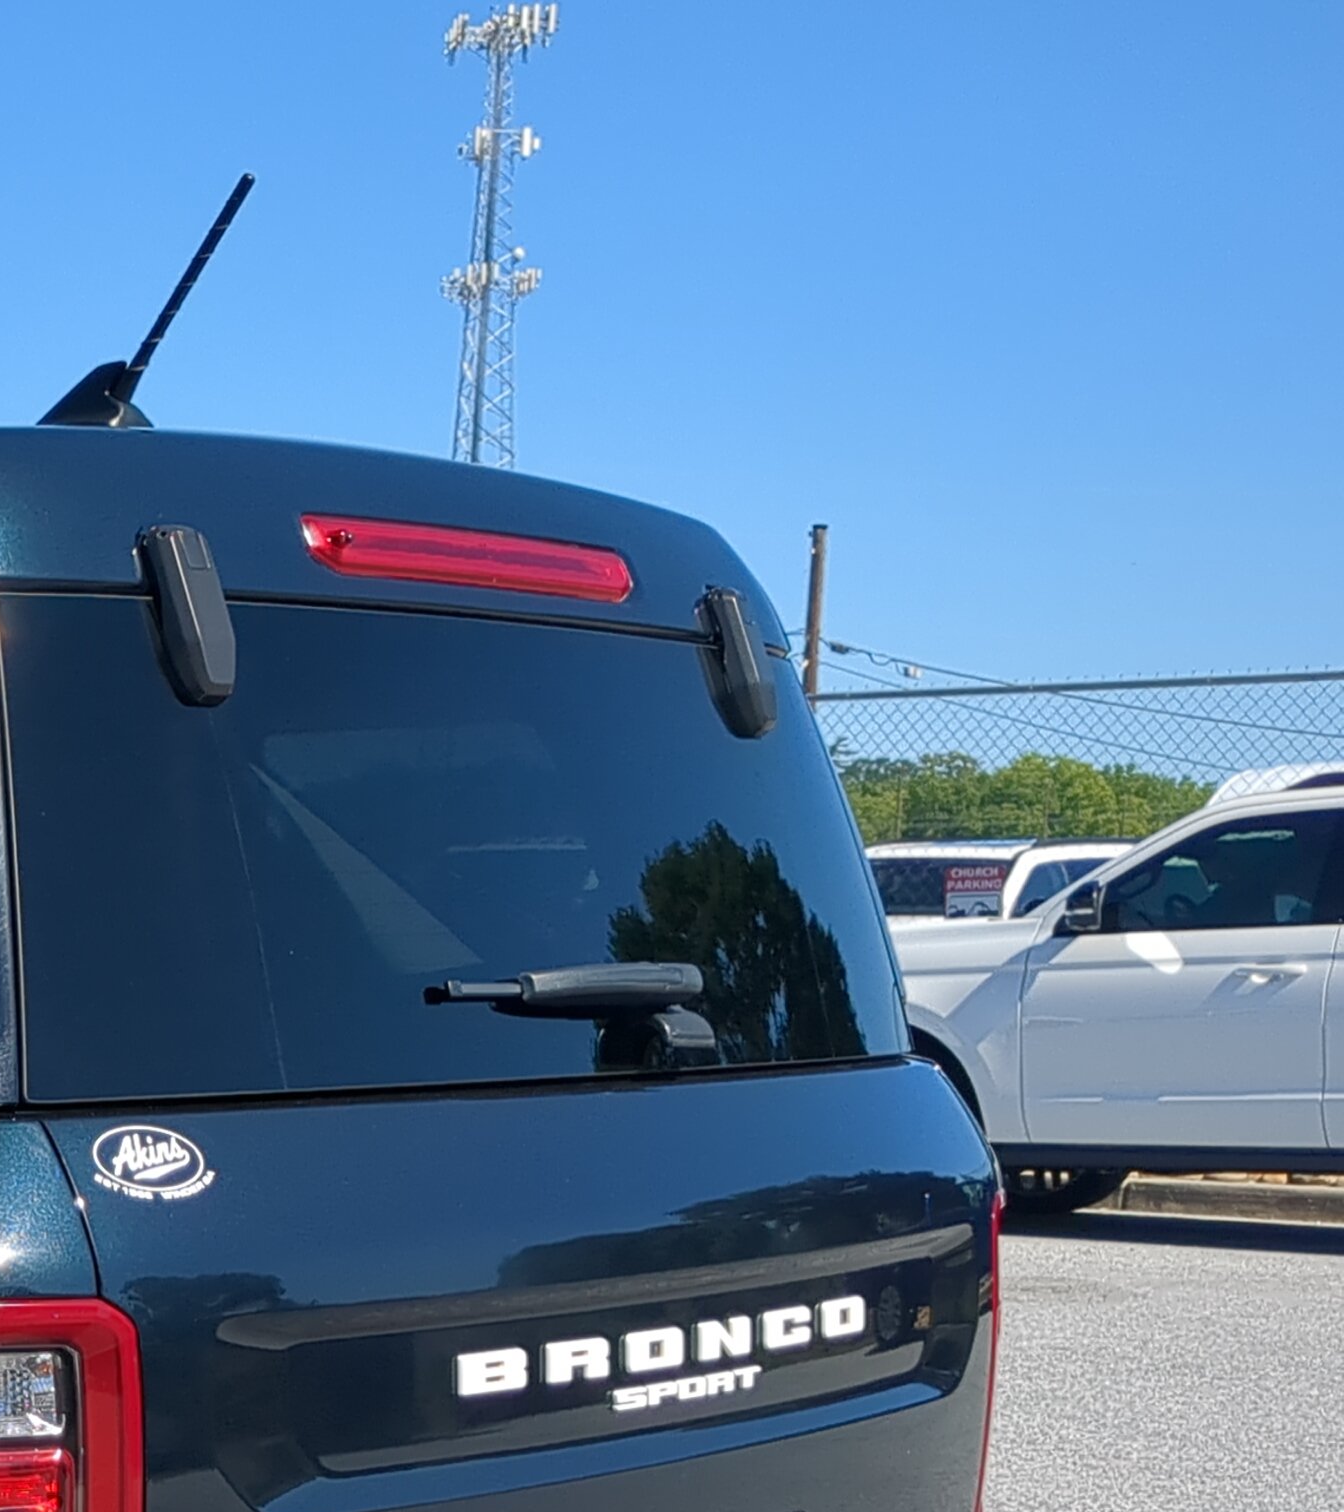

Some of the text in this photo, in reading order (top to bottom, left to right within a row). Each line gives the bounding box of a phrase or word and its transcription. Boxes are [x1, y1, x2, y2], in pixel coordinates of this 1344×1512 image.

[946, 878, 1003, 891] PARKING
[950, 866, 1000, 879] CHURCH
[112, 1133, 190, 1178] Akins
[453, 1295, 867, 1398] BRONCO
[609, 1365, 763, 1412] SPORT
